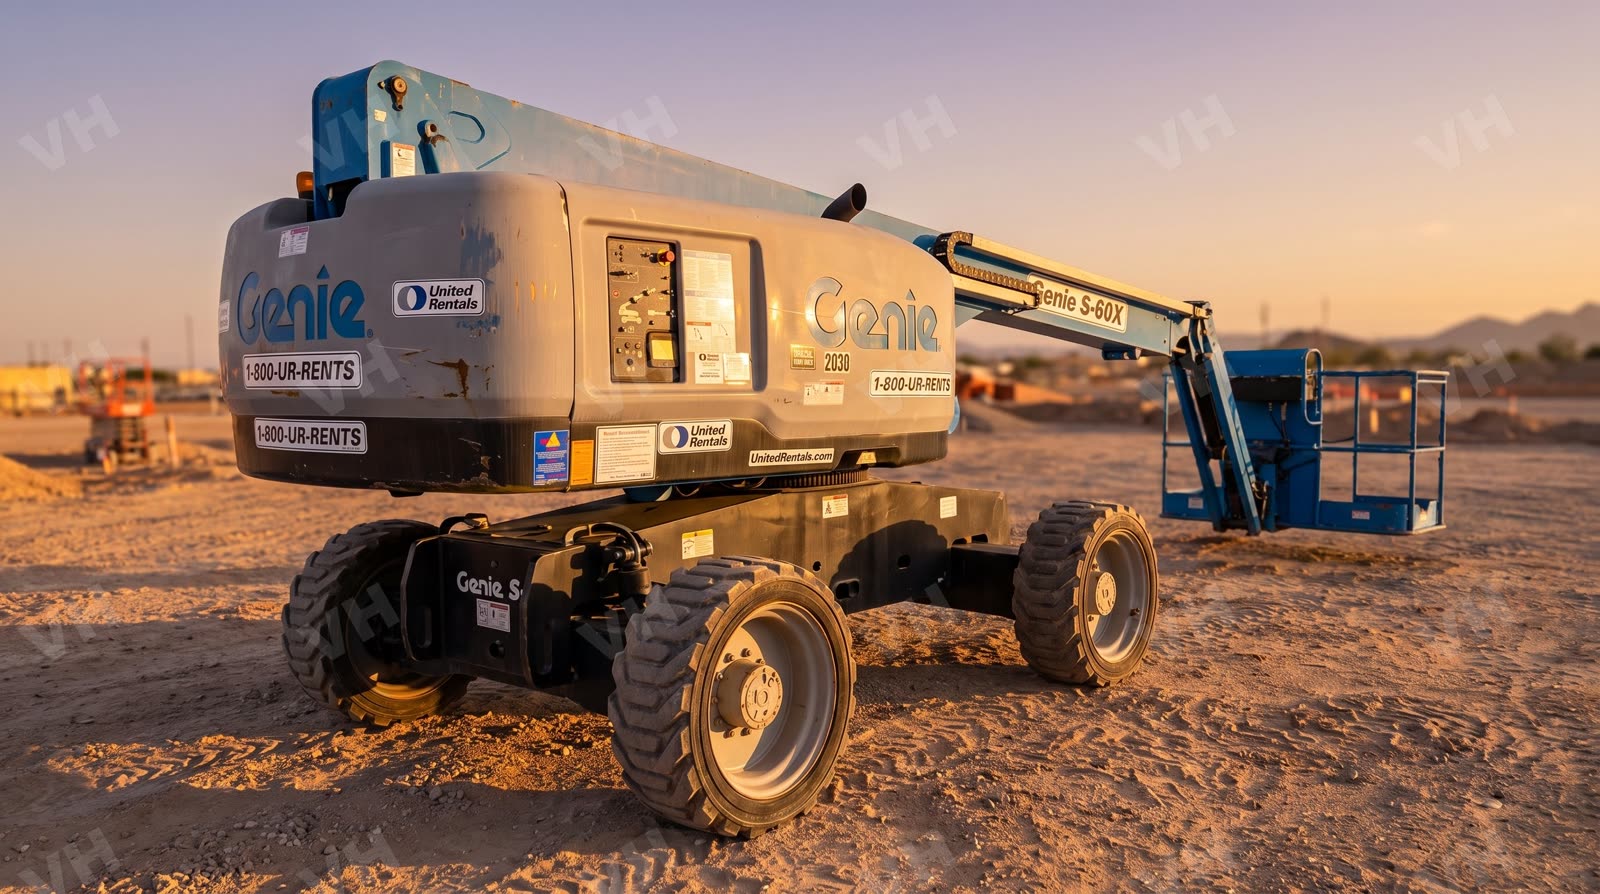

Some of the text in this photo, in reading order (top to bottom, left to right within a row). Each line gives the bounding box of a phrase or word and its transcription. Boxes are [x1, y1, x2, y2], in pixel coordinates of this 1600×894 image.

[428, 284, 473, 298] United
[237, 264, 366, 345] Genie
[428, 296, 478, 311] Rentals
[1080, 295, 1125, 326] S-60X
[805, 276, 938, 353] Genie
[246, 360, 355, 381] 1-800-UR-RENTS
[824, 353, 850, 372] 2030
[874, 376, 951, 392] 1-800-UR-RENTS
[257, 425, 361, 447] 1-800-UR-RENTS
[690, 424, 725, 437] United
[689, 435, 728, 449] Rentals
[750, 450, 833, 464] UnitedRentals.com
[456, 570, 504, 599] Genie
